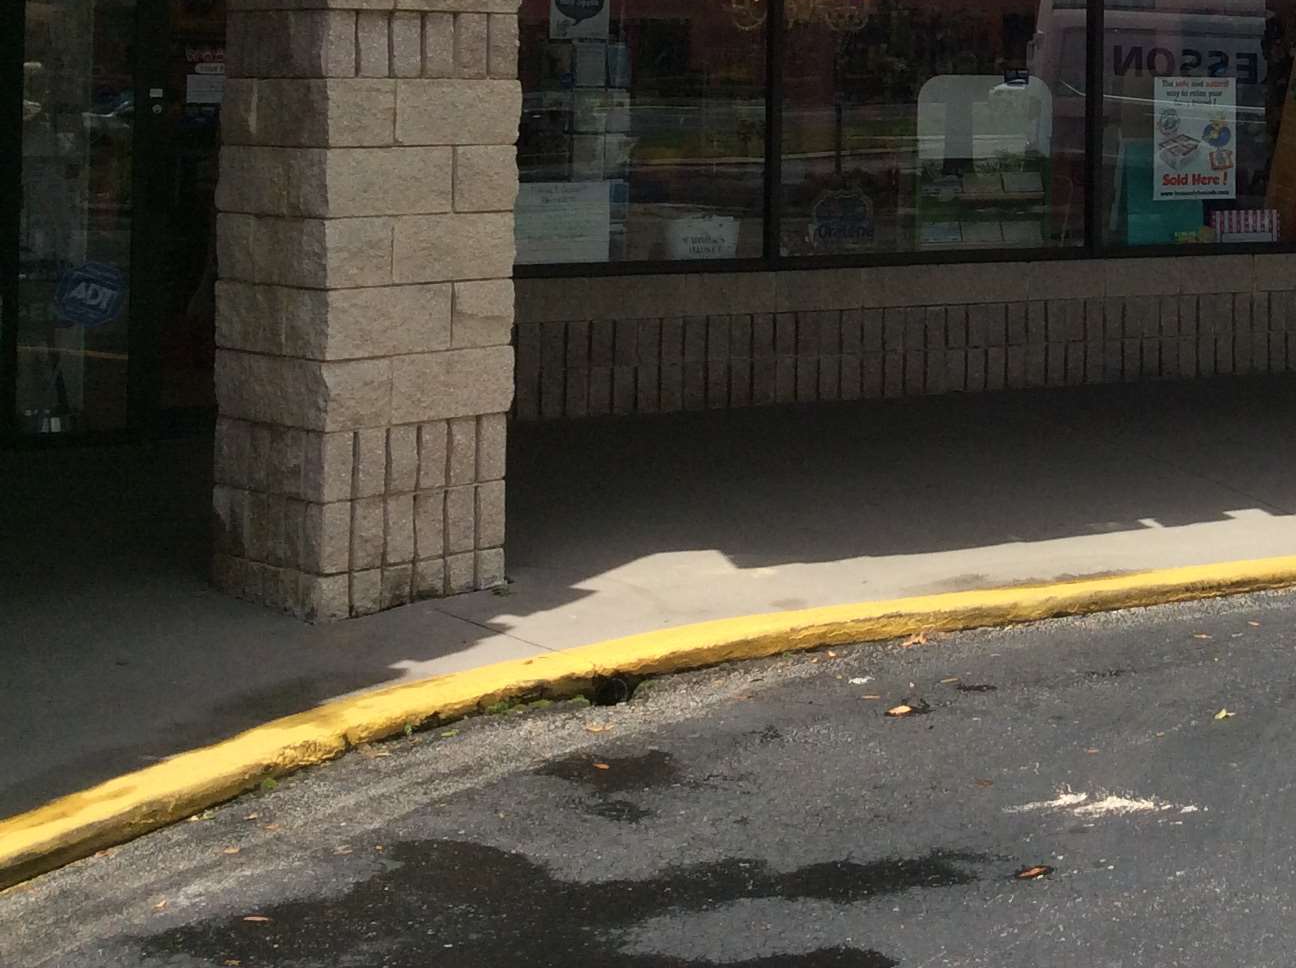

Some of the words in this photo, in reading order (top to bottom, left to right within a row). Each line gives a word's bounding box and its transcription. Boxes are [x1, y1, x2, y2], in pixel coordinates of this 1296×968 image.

[1162, 173, 1188, 186] Sold
[1192, 173, 1220, 186] Here
[62, 281, 117, 310] ADT
